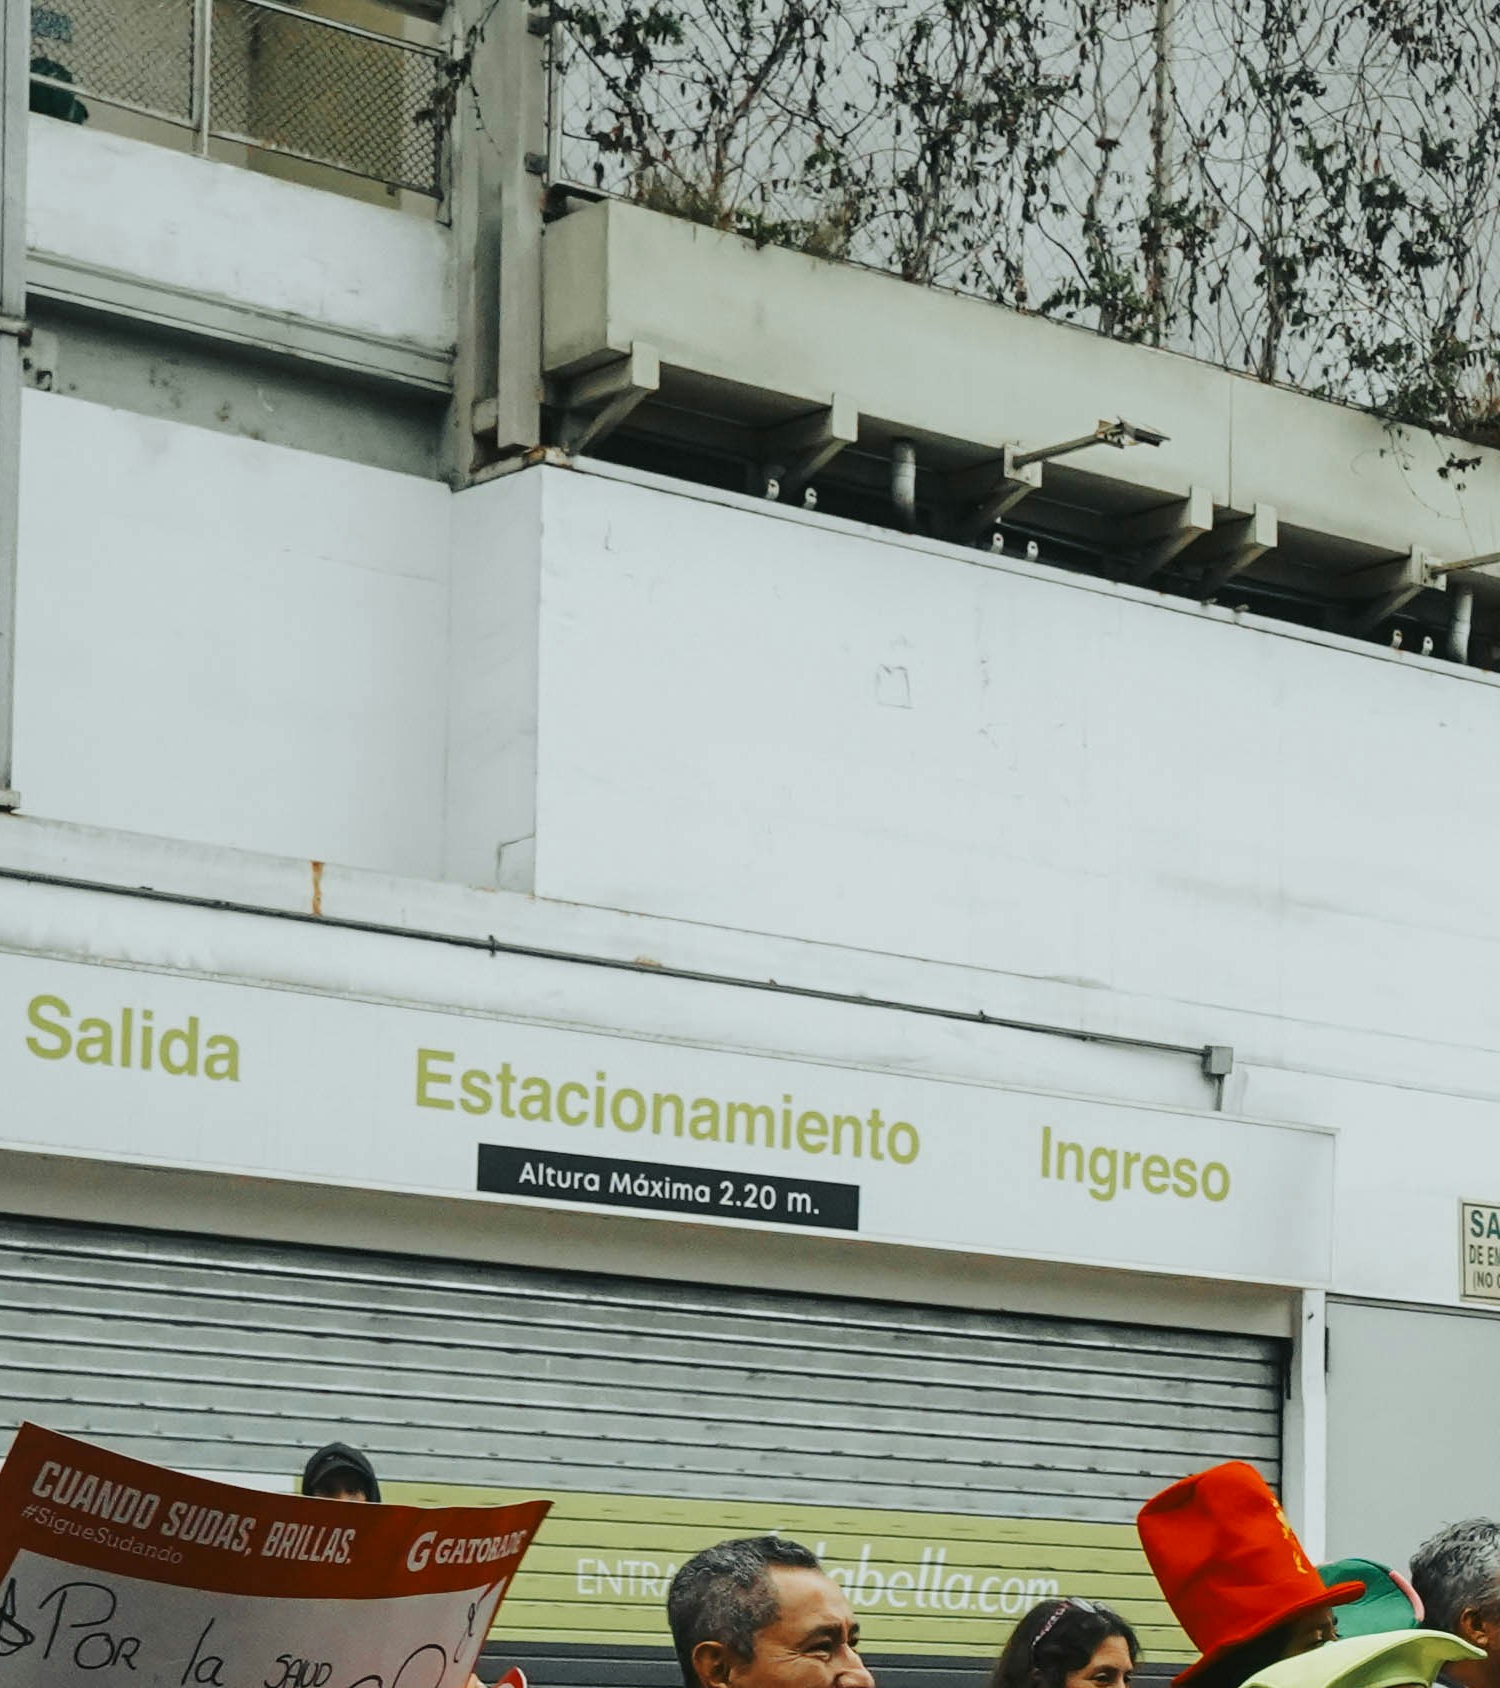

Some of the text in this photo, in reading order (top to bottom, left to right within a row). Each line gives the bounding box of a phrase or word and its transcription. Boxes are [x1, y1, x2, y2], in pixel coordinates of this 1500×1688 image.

[25, 994, 241, 1082] Salida
[414, 1047, 921, 1166] Estacionamiento
[518, 1161, 820, 1215] Altura Máxima 2.20 m.
[1040, 1125, 1231, 1202] Ingreso
[1469, 1244, 1484, 1265] DE
[1473, 1271, 1493, 1291] (NO
[19, 1502, 184, 1566] #SigueSudando
[31, 1460, 356, 1565] CUANDO SUDAS, BRILLAS.
[434, 1529, 528, 1565] GATORADE
